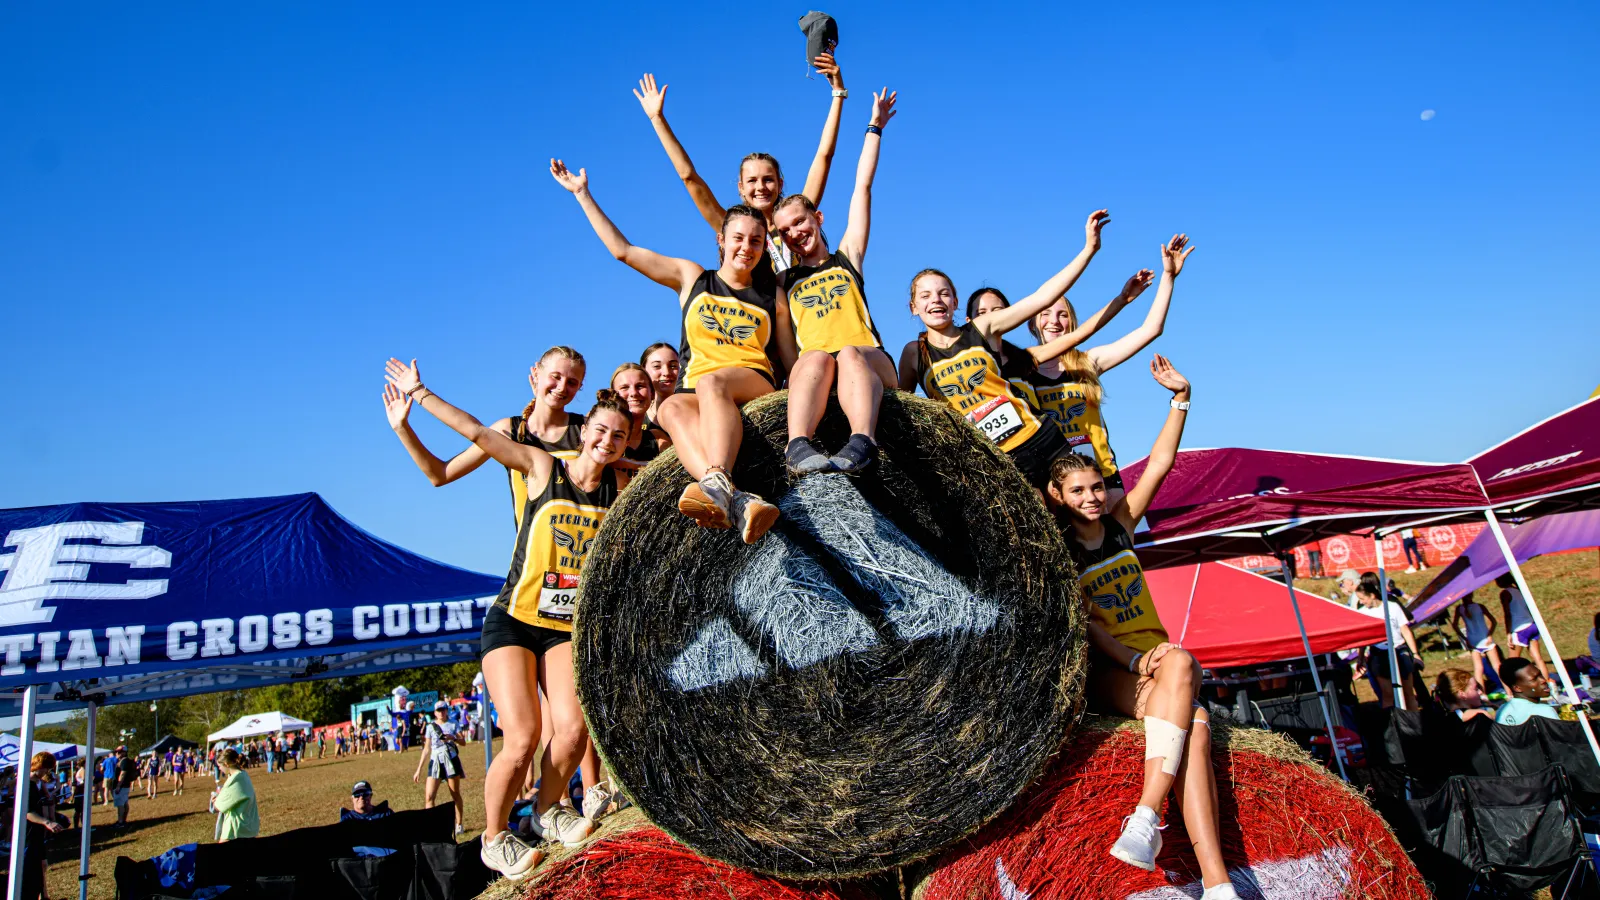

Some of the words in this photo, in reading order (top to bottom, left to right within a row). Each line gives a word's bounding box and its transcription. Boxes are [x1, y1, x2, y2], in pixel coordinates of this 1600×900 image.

[793, 274, 850, 301] RICHMOND
[698, 303, 761, 327] RICHMOND
[816, 300, 842, 318] HILL
[959, 392, 986, 409] HILL
[1061, 423, 1080, 433] ILL
[550, 514, 599, 529] RICHMO
[560, 556, 582, 570] HIL
[1116, 604, 1144, 624] HILL
[166, 608, 334, 661] CROSS
